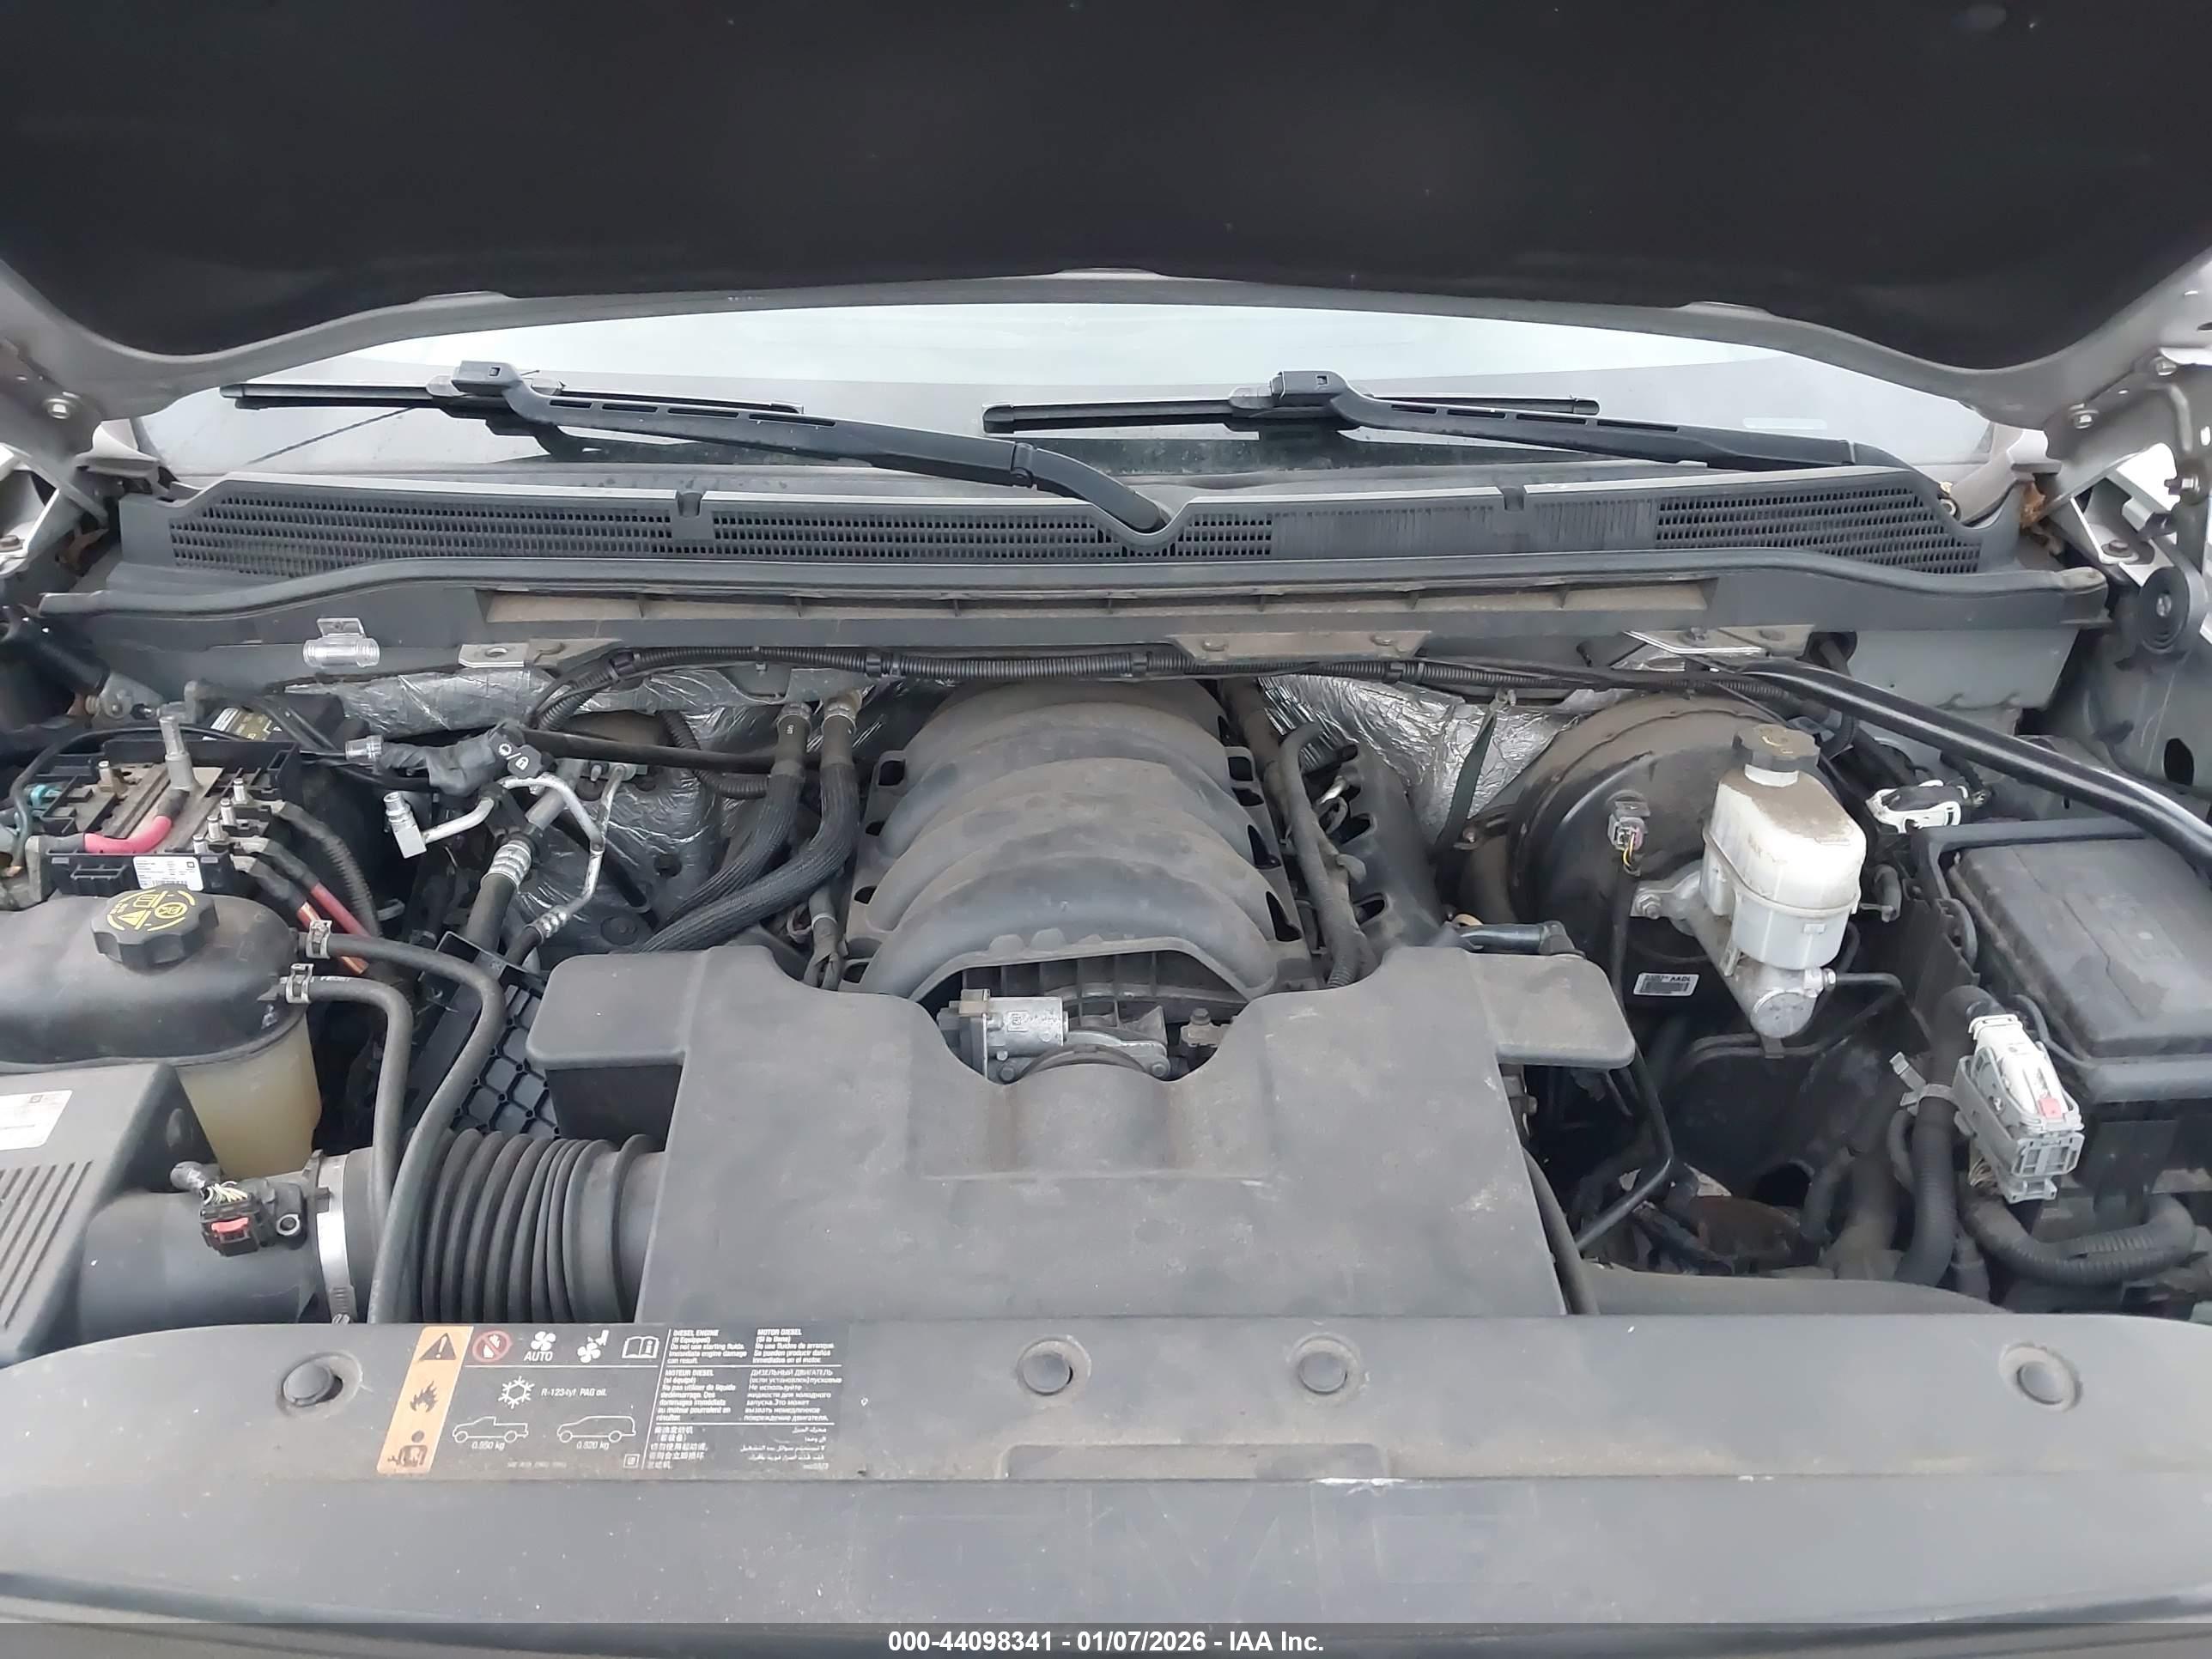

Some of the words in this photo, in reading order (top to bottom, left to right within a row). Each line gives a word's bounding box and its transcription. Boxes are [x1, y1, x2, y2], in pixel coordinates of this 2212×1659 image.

[524, 1351, 554, 1362] AUTO
[495, 1441, 505, 1451] kg
[599, 1441, 610, 1451] kg
